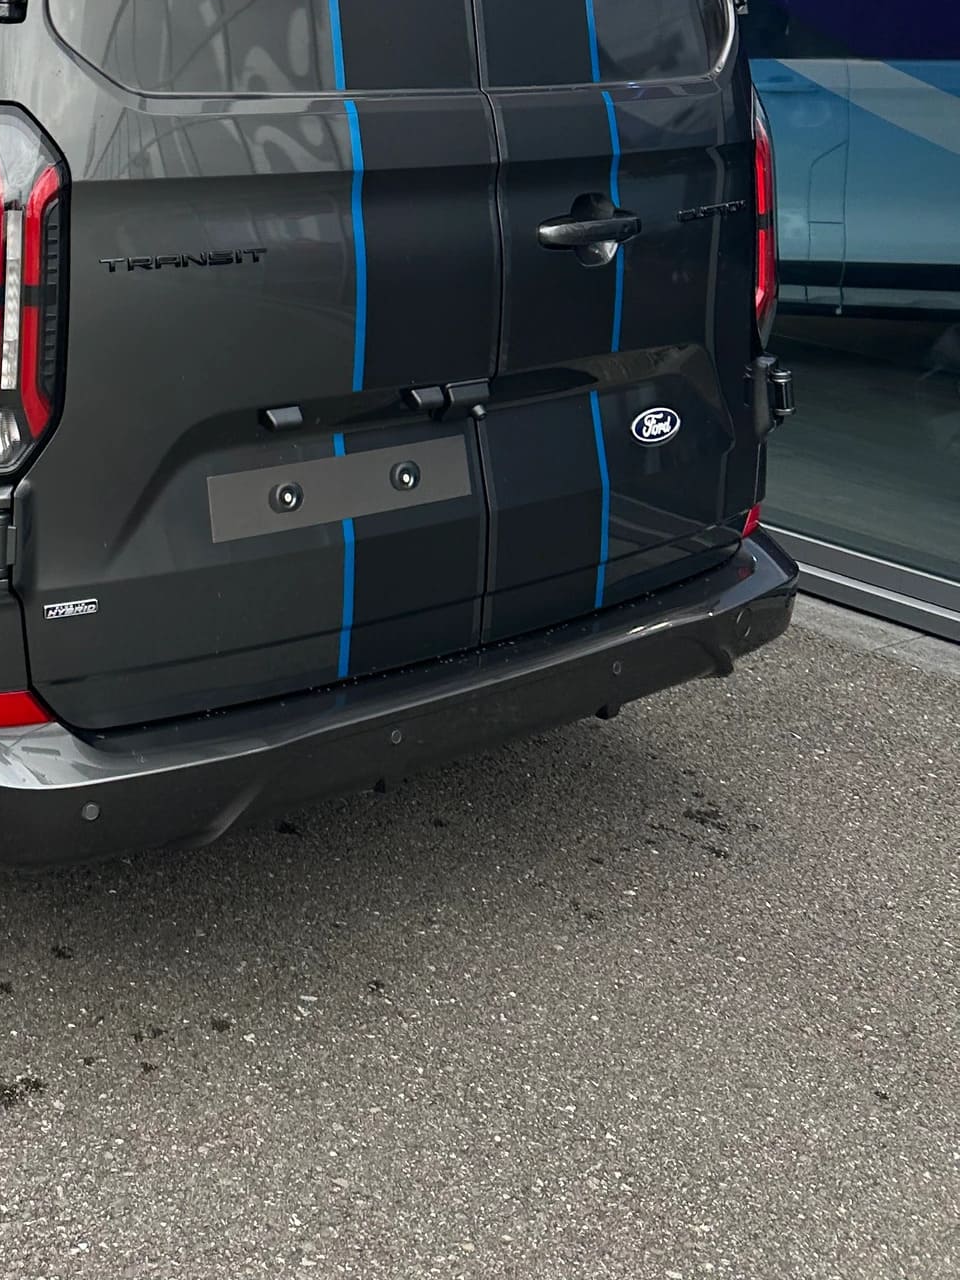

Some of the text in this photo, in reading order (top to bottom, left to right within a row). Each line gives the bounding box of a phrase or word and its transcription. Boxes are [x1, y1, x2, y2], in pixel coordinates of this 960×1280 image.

[99, 248, 268, 273] TRANSIT
[642, 413, 672, 438] Ford
[47, 603, 96, 617] HYBRID
